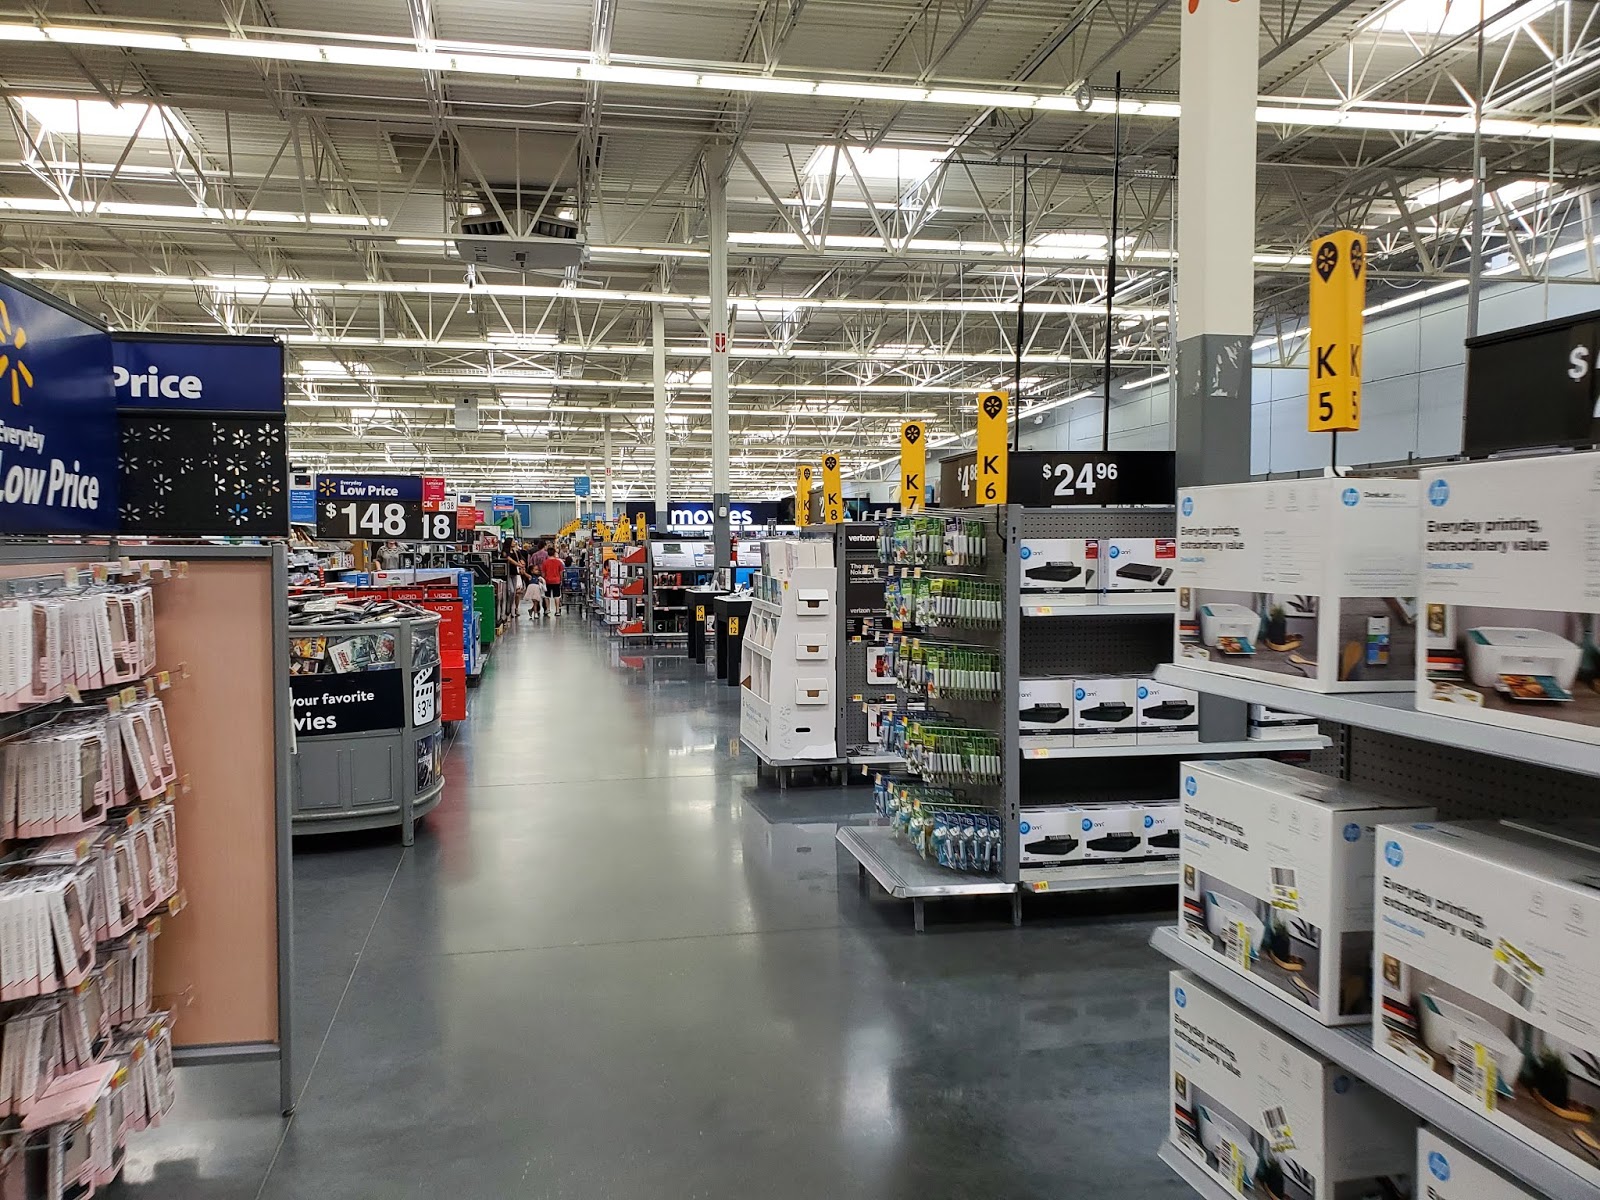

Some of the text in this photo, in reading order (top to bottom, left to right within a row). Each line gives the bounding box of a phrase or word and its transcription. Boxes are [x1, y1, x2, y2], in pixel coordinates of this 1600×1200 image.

[1316, 343, 1337, 379] K
[1350, 343, 1360, 378] K
[113, 365, 203, 399] Price
[1319, 391, 1334, 422] 5
[983, 455, 999, 474] K
[46, 458, 99, 510] Price
[340, 485, 399, 497] Low Price
[906, 474, 919, 490] K
[985, 482, 996, 500] 6
[828, 493, 838, 505] K
[908, 496, 917, 510] 7
[831, 509, 838, 520] 8
[1427, 519, 1481, 534] Everyday
[848, 534, 876, 542] verizon
[1427, 537, 1549, 553] extraordinary value
[730, 617, 737, 625] K
[322, 690, 375, 704] favorite
[294, 711, 337, 731] vies
[1184, 804, 1215, 825] Everyday
[1383, 876, 1433, 907] Everyday
[1383, 895, 1457, 936] extraordinary
[1459, 925, 1494, 949] value
[1174, 1013, 1205, 1042] Everyday
